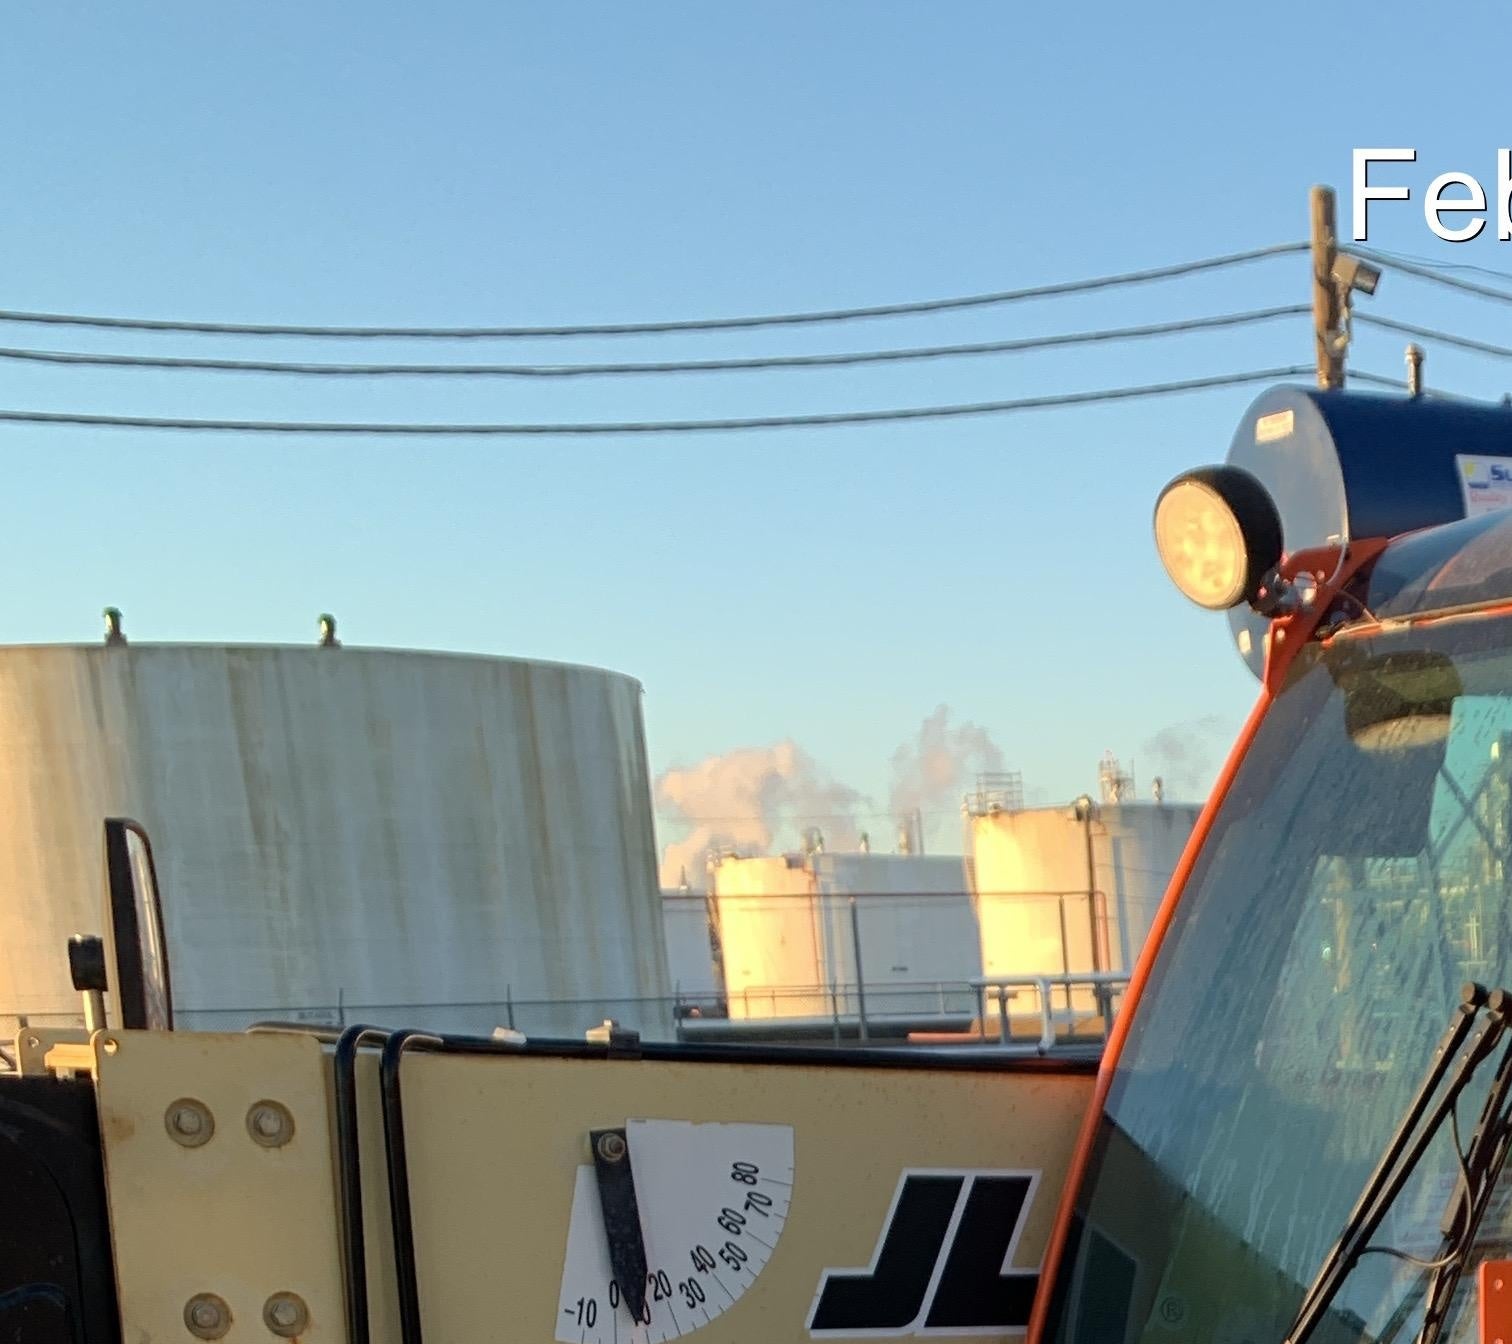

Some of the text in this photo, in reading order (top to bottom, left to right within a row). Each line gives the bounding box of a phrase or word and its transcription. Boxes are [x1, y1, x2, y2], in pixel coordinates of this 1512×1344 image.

[731, 1161, 760, 1186] 80
[744, 1191, 773, 1218] 70
[717, 1207, 747, 1236] 60
[690, 1245, 717, 1274] 40
[718, 1241, 748, 1272] 50
[609, 1279, 620, 1309] 0
[648, 1269, 672, 1302] 20
[679, 1277, 706, 1309] 30
[564, 1297, 597, 1328] -10
